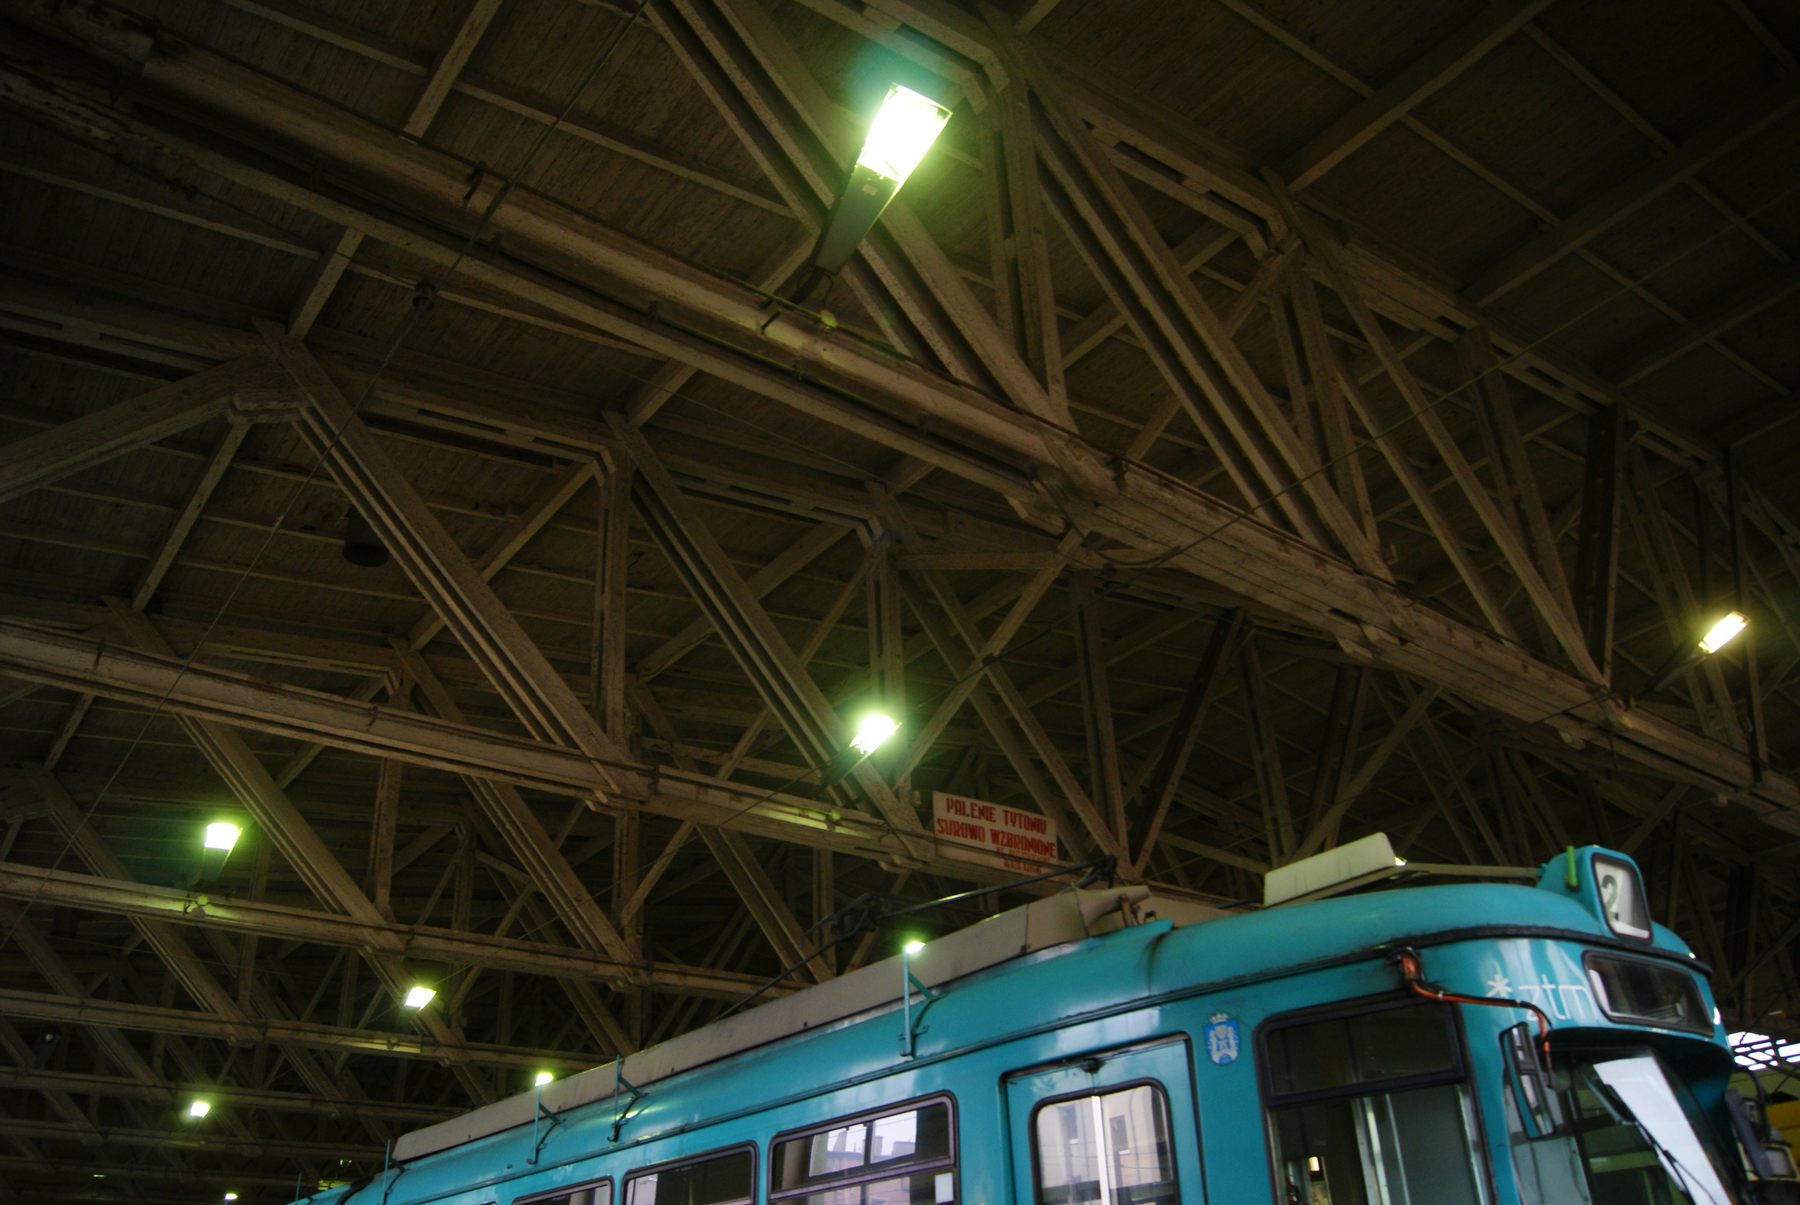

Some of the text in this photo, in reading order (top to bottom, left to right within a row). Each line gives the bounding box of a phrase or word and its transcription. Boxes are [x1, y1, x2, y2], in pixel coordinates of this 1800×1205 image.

[946, 797, 1047, 835] PALENIE TYTONIU
[936, 818, 985, 842] SUROWO
[990, 828, 1057, 859] WZBRONIONE
[1602, 874, 1619, 921] 2
[1518, 973, 1598, 1021] ztm
